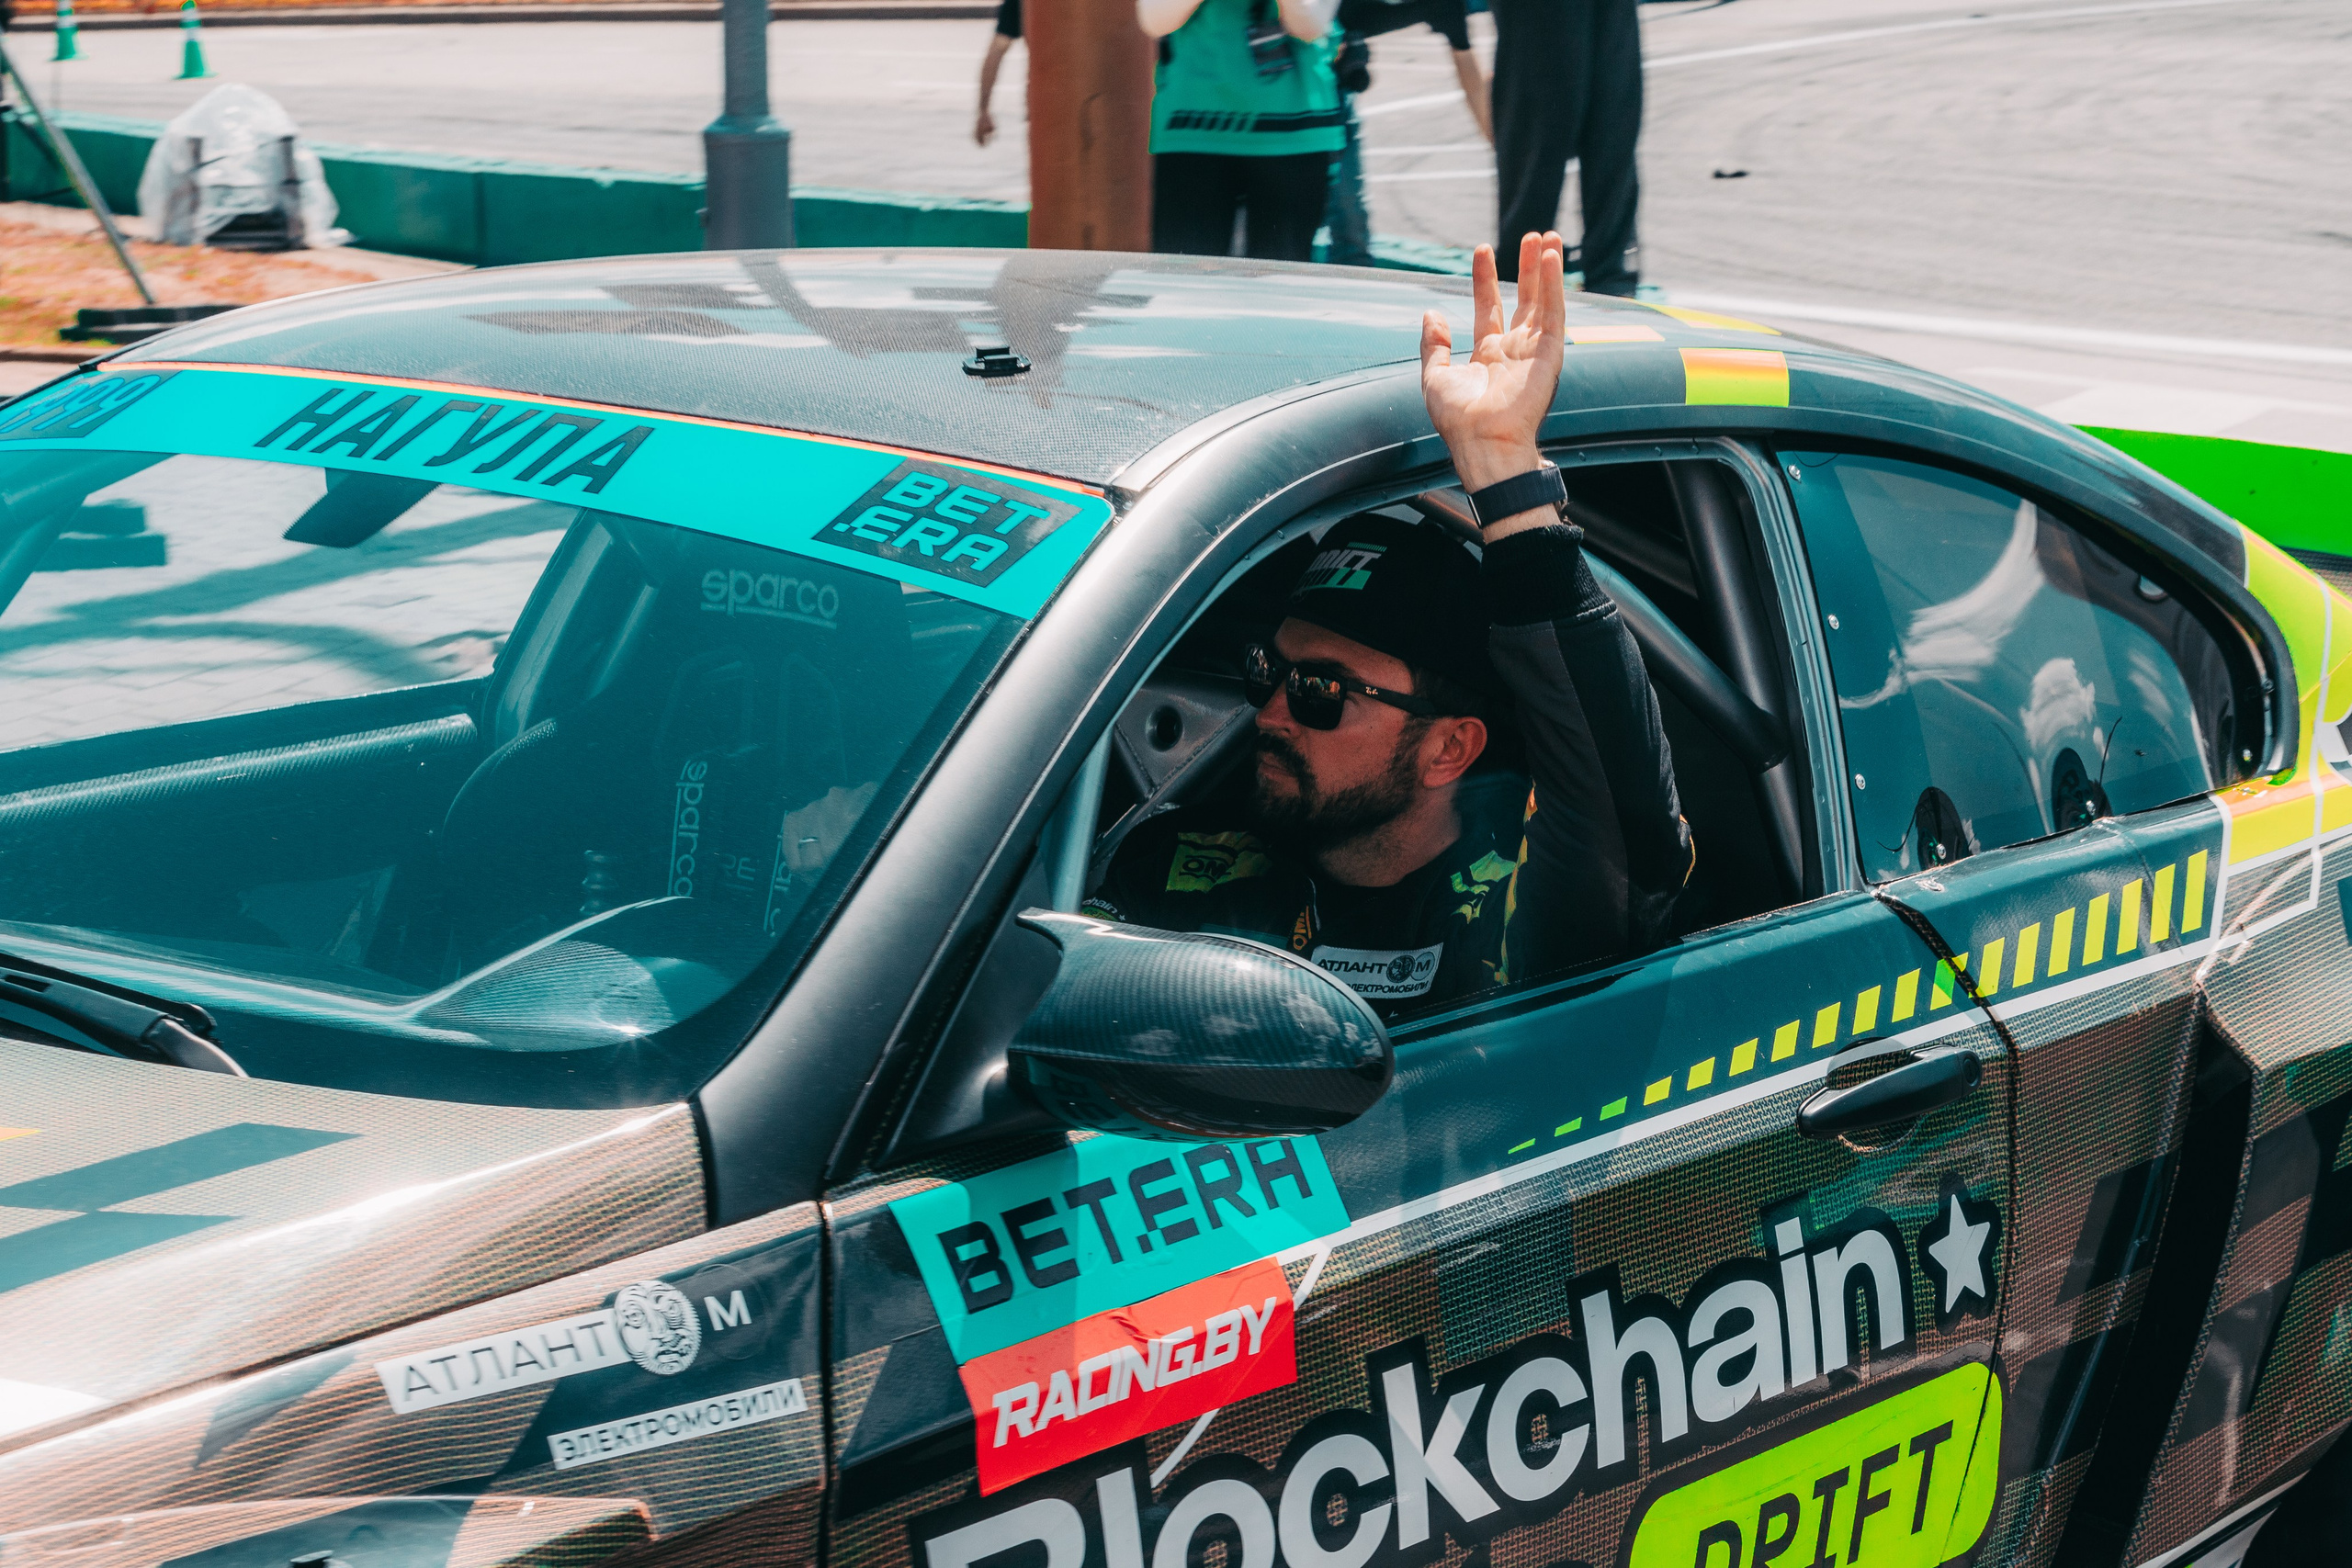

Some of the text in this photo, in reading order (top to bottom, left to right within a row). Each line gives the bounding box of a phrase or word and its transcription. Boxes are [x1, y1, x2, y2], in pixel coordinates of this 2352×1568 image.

[254, 388, 655, 494] НАГУЛА
[882, 470, 1050, 536] BET
[701, 569, 840, 620] sparco
[673, 761, 707, 897] sparco
[1317, 958, 1388, 974] АТЛАНТ
[1347, 980, 1430, 993] ЛЕКТРОМОБИЛИ
[935, 1139, 1314, 1314] BET.ERA
[402, 1320, 610, 1403] АТЛАНТ
[992, 1296, 1277, 1449] RACING.BY
[559, 1384, 800, 1461] ЭЛЕКТРОМОБИЛИ
